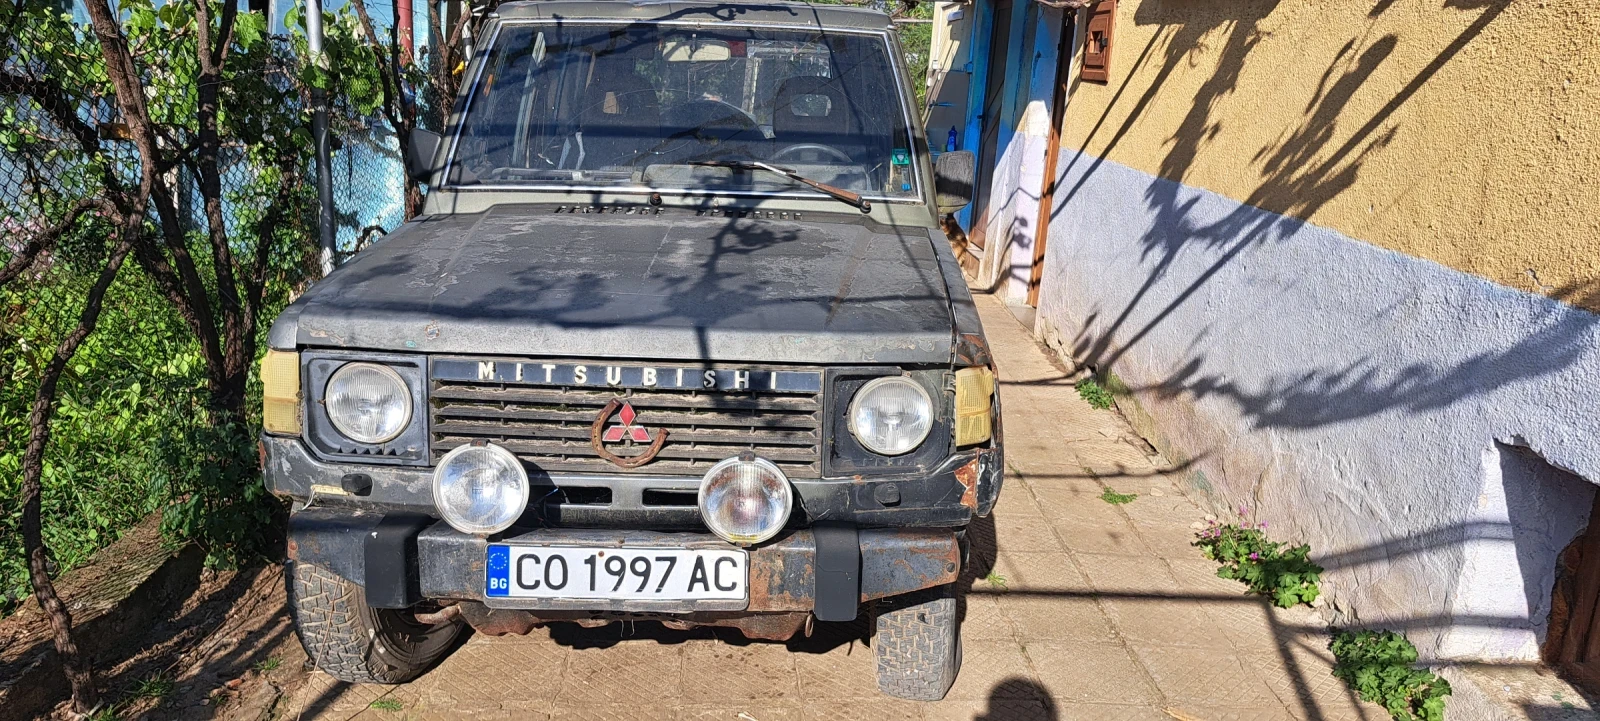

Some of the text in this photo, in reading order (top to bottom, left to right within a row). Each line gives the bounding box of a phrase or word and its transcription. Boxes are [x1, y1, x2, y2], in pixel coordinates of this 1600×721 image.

[478, 361, 777, 390] MITSUBISHI
[490, 578, 507, 589] BG
[516, 553, 738, 593] CO 1997 AC
